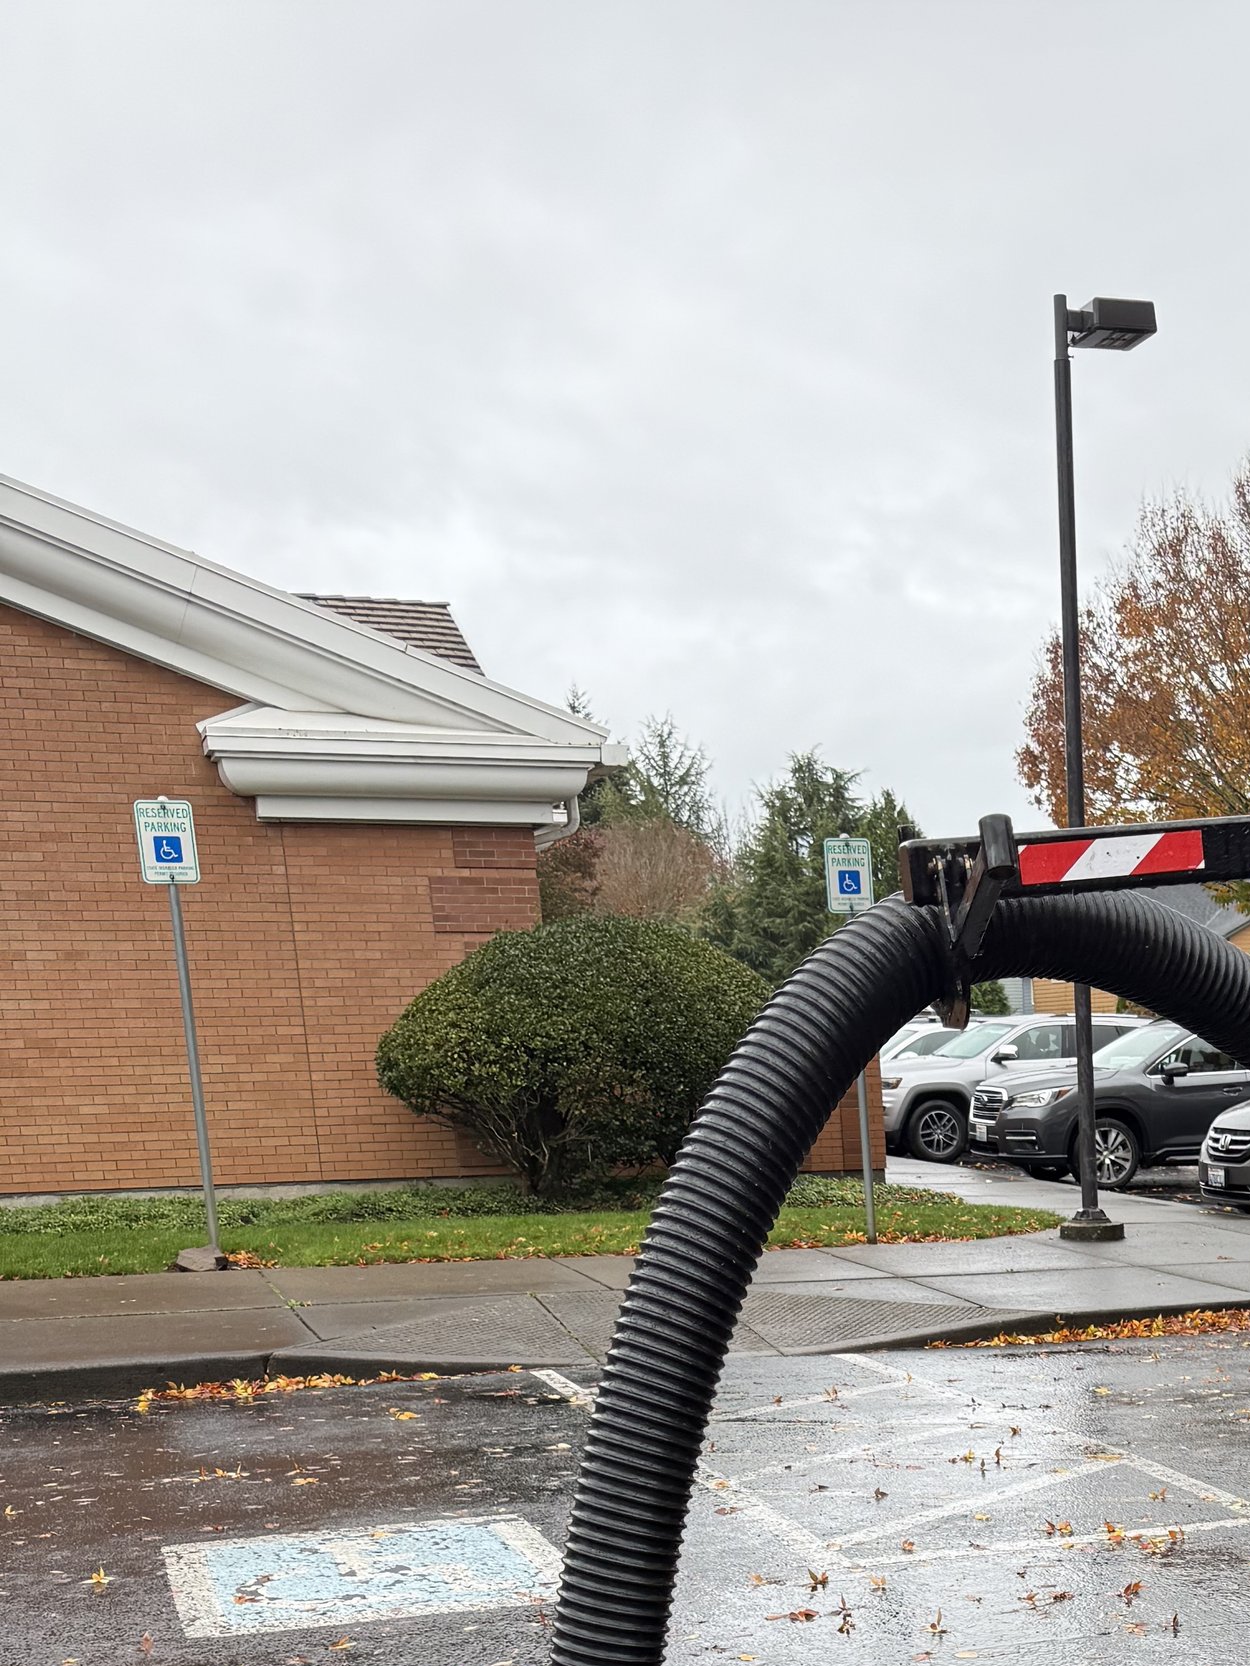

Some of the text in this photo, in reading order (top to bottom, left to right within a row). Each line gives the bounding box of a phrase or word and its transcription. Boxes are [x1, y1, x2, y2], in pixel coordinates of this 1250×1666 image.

[139, 808, 188, 818] RESERVED
[144, 822, 186, 832] PARKING
[828, 845, 867, 854] RESERVED
[832, 858, 865, 867] PARKING
